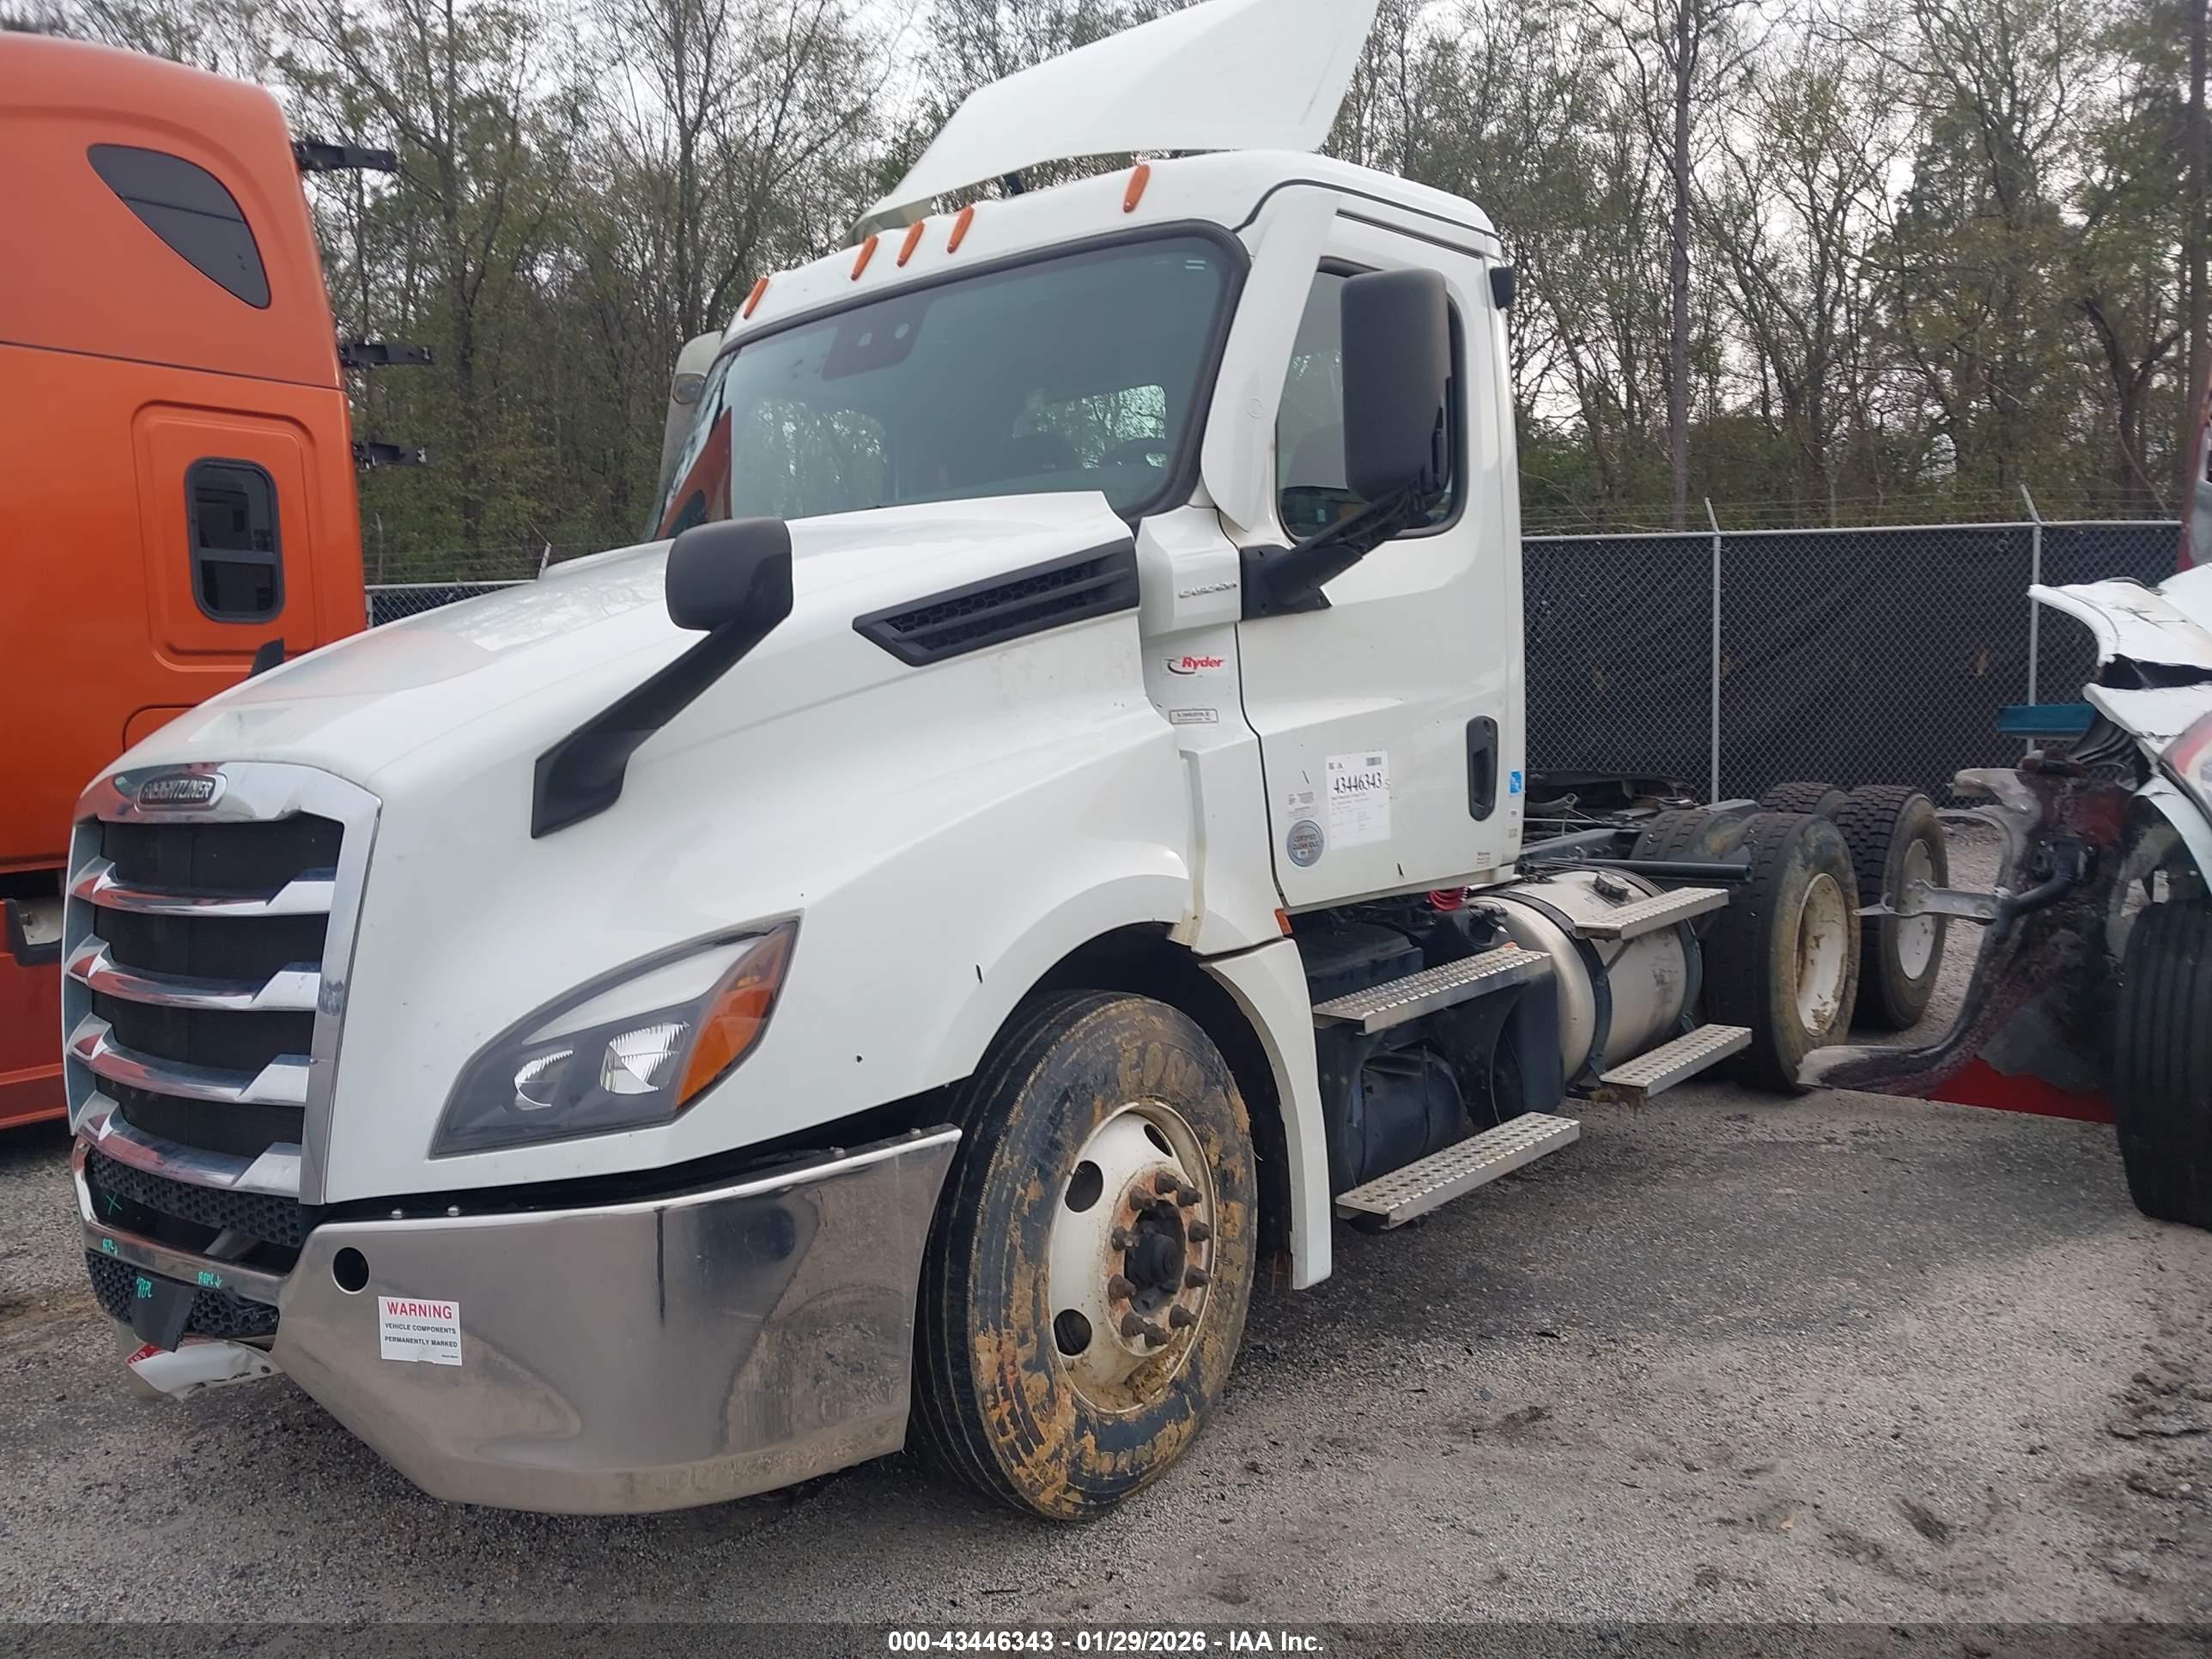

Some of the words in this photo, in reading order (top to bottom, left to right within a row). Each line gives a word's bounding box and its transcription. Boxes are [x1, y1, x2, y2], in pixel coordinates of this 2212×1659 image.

[1182, 657, 1223, 670] Ryder
[141, 779, 215, 799] FREIGHTLINER
[1334, 772, 1382, 793] 43446343
[387, 1302, 453, 1319] WARNING
[385, 1322, 411, 1331] VEHICLE
[412, 1324, 457, 1334] COMPONENTS
[384, 1336, 430, 1346] PERMANENTLY
[431, 1340, 458, 1348] MARKED
